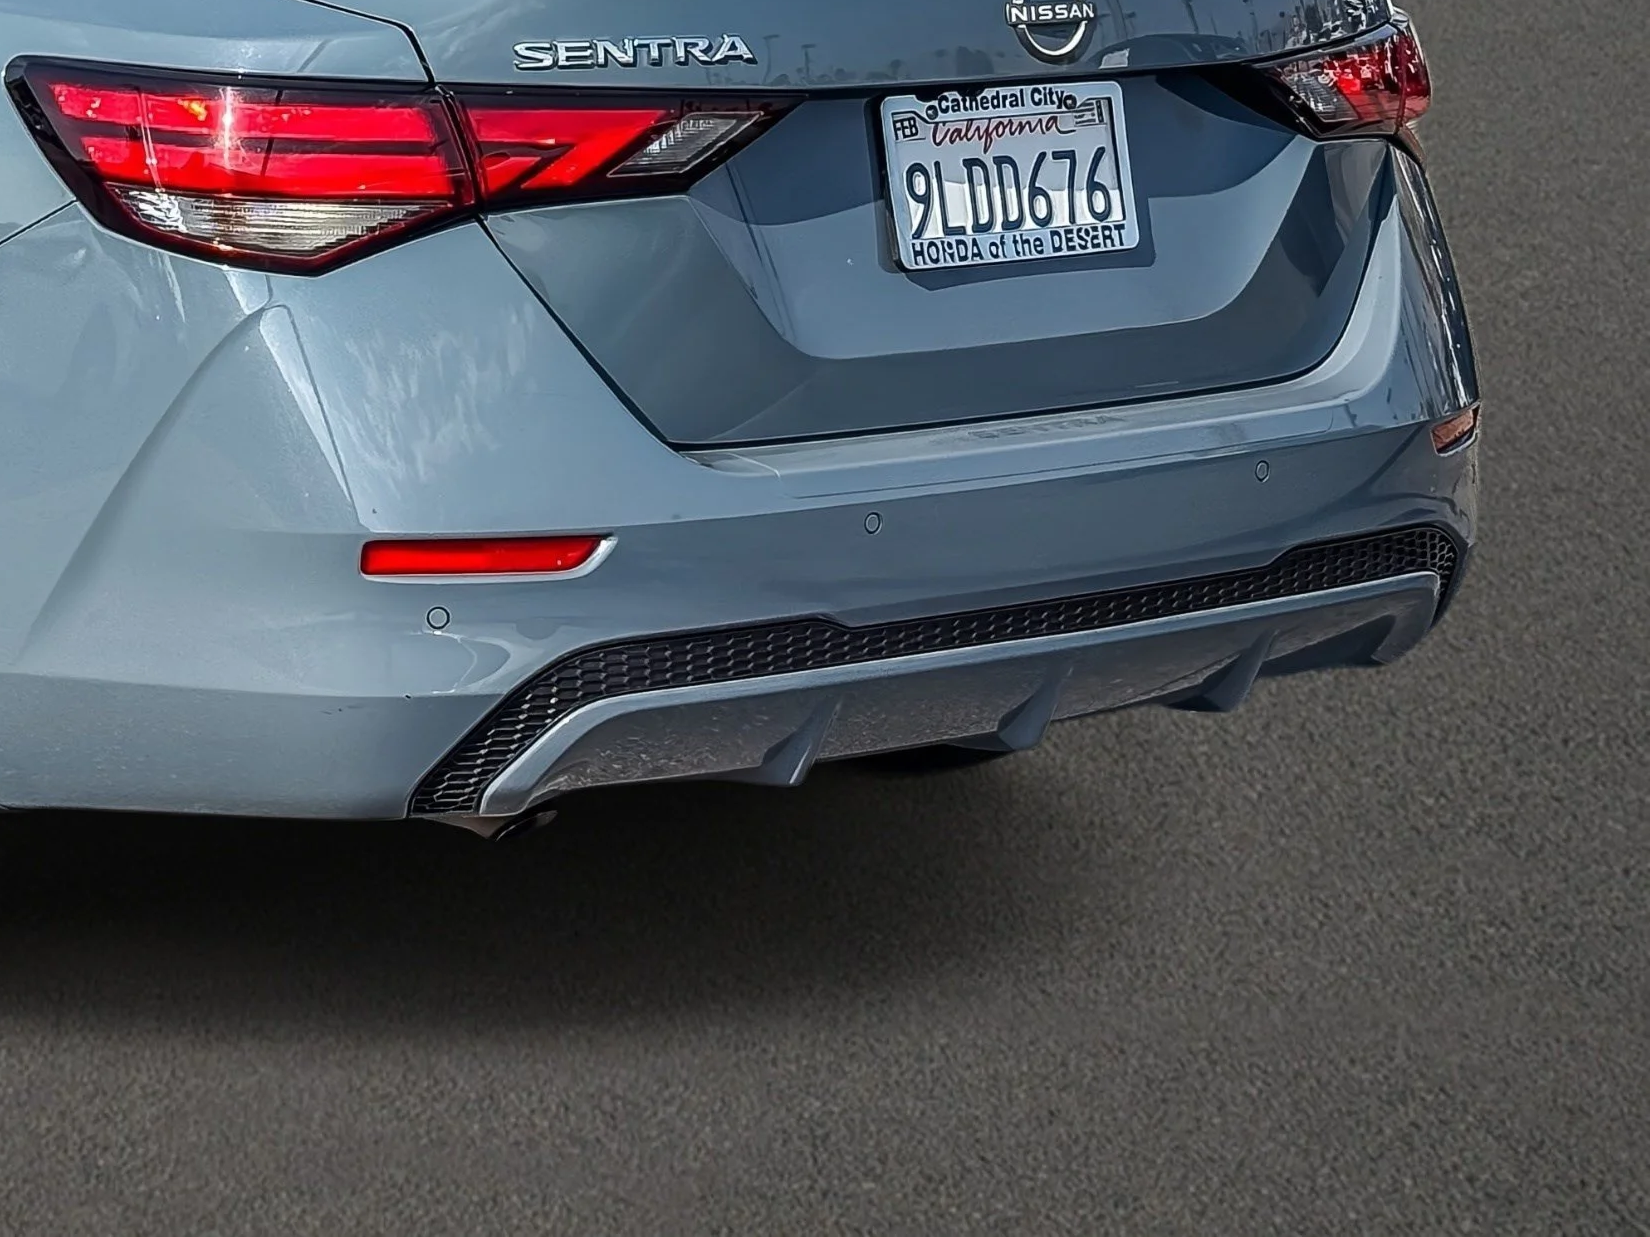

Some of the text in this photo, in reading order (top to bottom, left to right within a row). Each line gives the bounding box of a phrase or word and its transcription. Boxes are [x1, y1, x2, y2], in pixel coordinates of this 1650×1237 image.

[1010, 2, 1095, 23] NISSAN
[512, 32, 758, 70] SENTRA
[937, 86, 1066, 115] Cathedral City
[932, 115, 1077, 154] California
[905, 146, 1113, 239] 9LDD676
[911, 223, 1127, 266] HONDA of the DESERT
